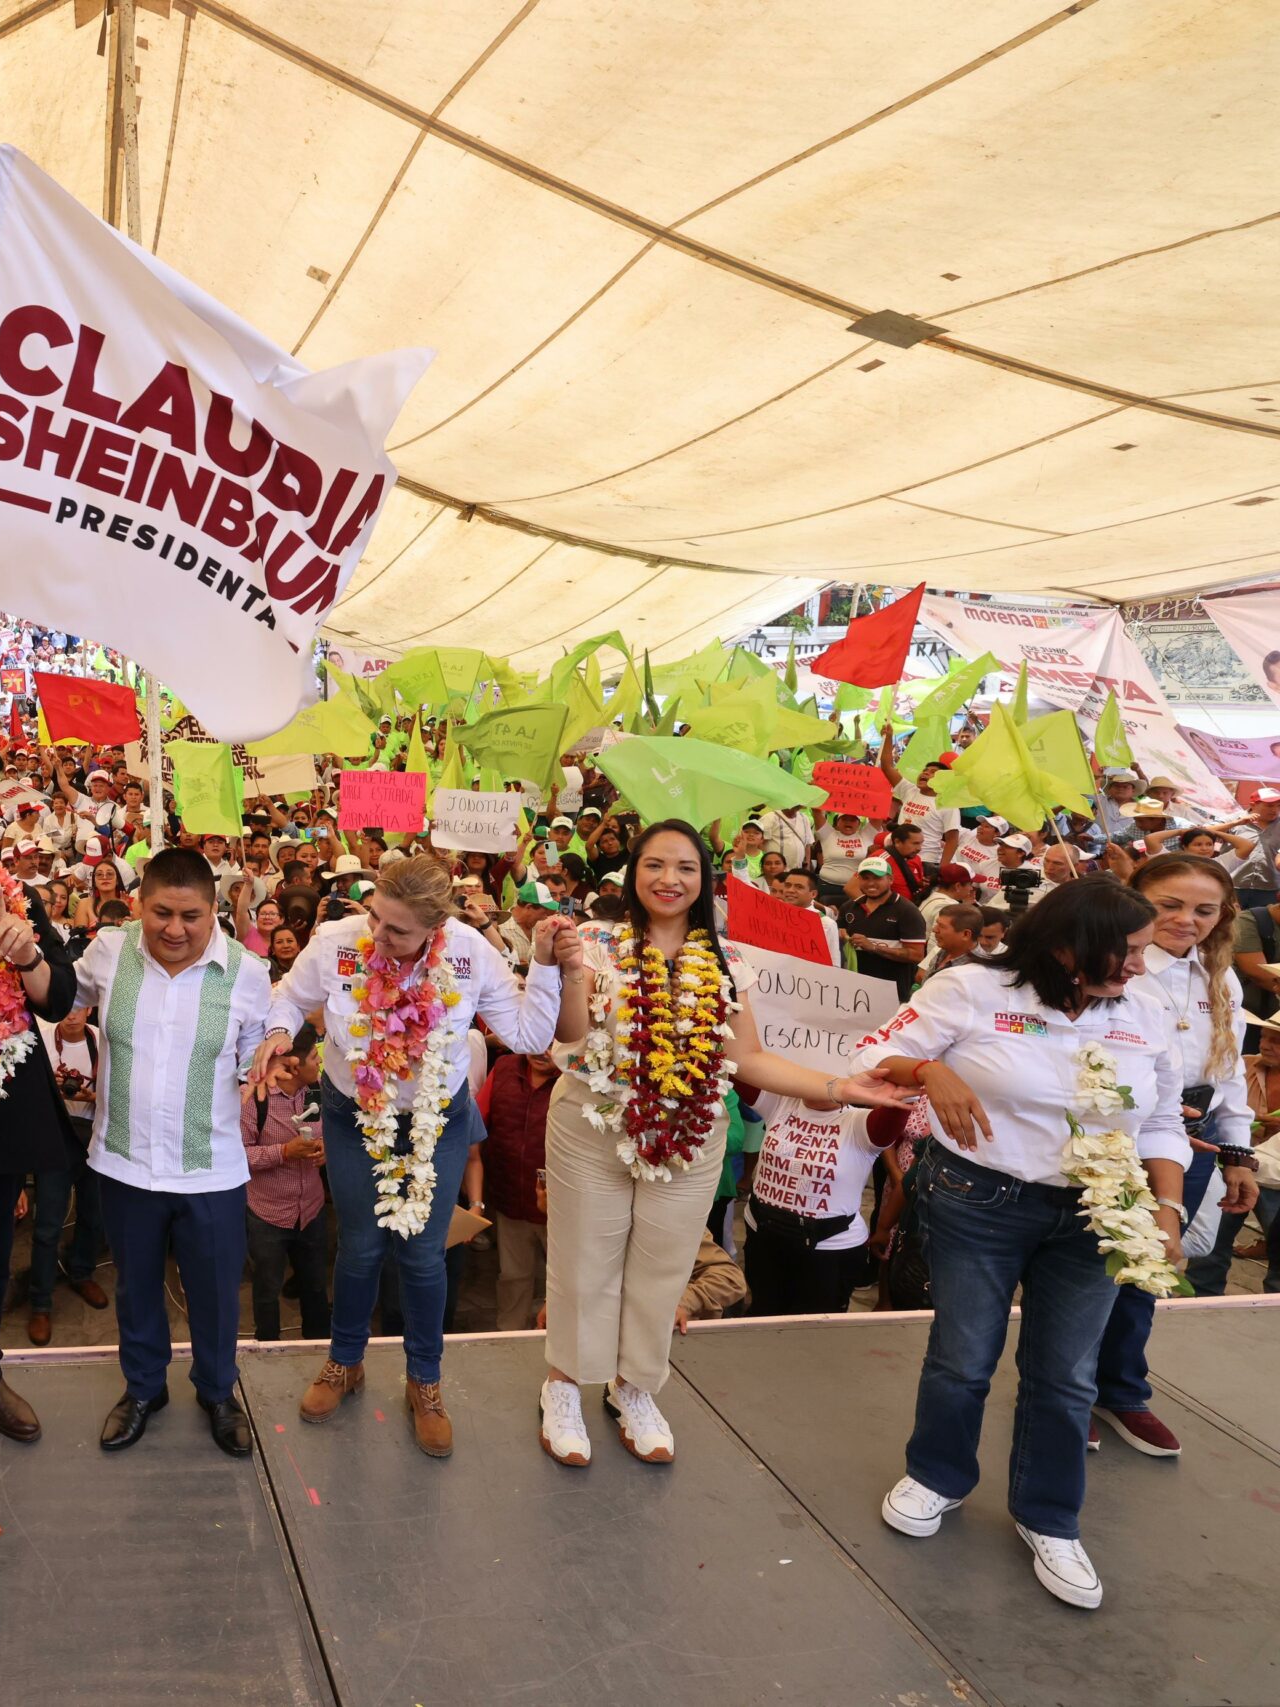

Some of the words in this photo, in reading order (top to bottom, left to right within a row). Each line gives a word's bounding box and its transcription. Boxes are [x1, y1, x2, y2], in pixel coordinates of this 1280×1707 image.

[54, 497, 278, 631] PRESIDENTA
[964, 607, 1034, 628] morena
[1039, 646, 1068, 655] JUNIO
[69, 695, 101, 715] PT
[404, 773, 424, 788] CON
[371, 786, 416, 806] ESTRADA
[343, 813, 400, 828] ARMENTA
[340, 966, 353, 976] PT
[757, 968, 870, 1013] ONOTLA
[994, 1012, 1047, 1026] morena
[1010, 1025, 1023, 1033] PT
[1109, 1030, 1141, 1039] ESTHER
[764, 1135, 838, 1166] ARMENTA
[761, 1149, 836, 1182] ARMENTA
[759, 1164, 831, 1196] ARMENTA
[755, 1179, 829, 1212] ARMENTA
